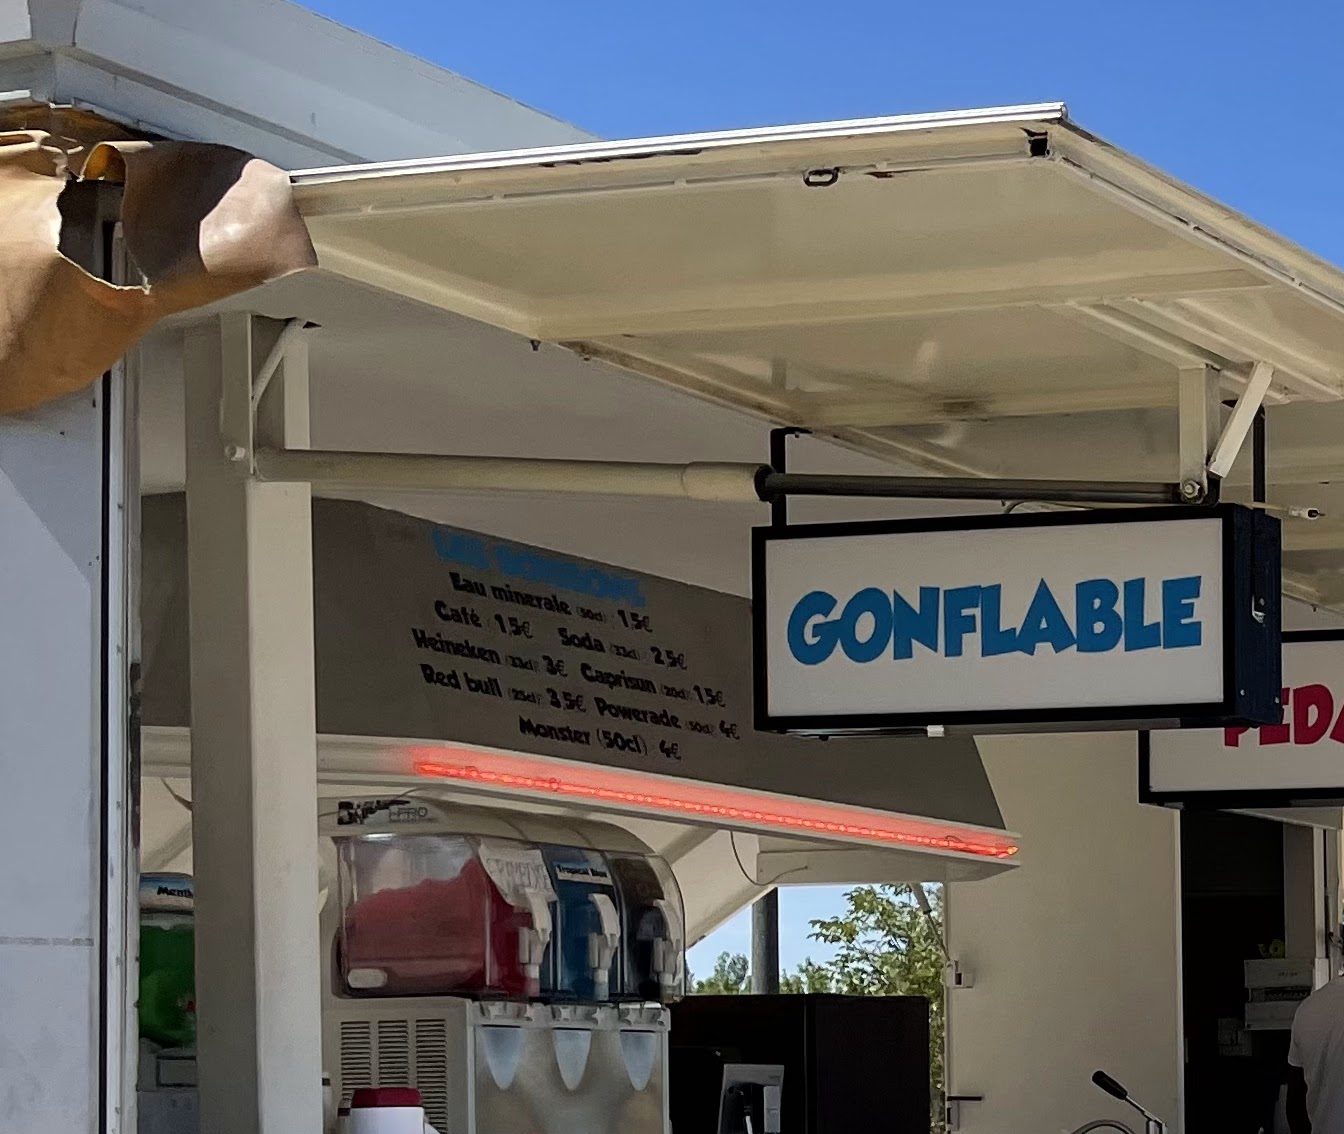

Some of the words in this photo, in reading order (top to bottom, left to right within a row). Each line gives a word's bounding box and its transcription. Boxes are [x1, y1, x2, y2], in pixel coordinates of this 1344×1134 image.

[449, 572, 486, 596] Eau
[435, 600, 482, 627] Café
[558, 627, 605, 652] Soda
[787, 575, 1202, 666] GONFLABLE
[411, 628, 500, 664] Heineken
[542, 655, 567, 677] 3€
[580, 663, 657, 693] Caprisun
[420, 664, 461, 690] Red
[463, 672, 502, 697] bull
[594, 697, 681, 728] Powerade
[519, 715, 590, 744] Monster
[597, 728, 648, 755] (50cl)
